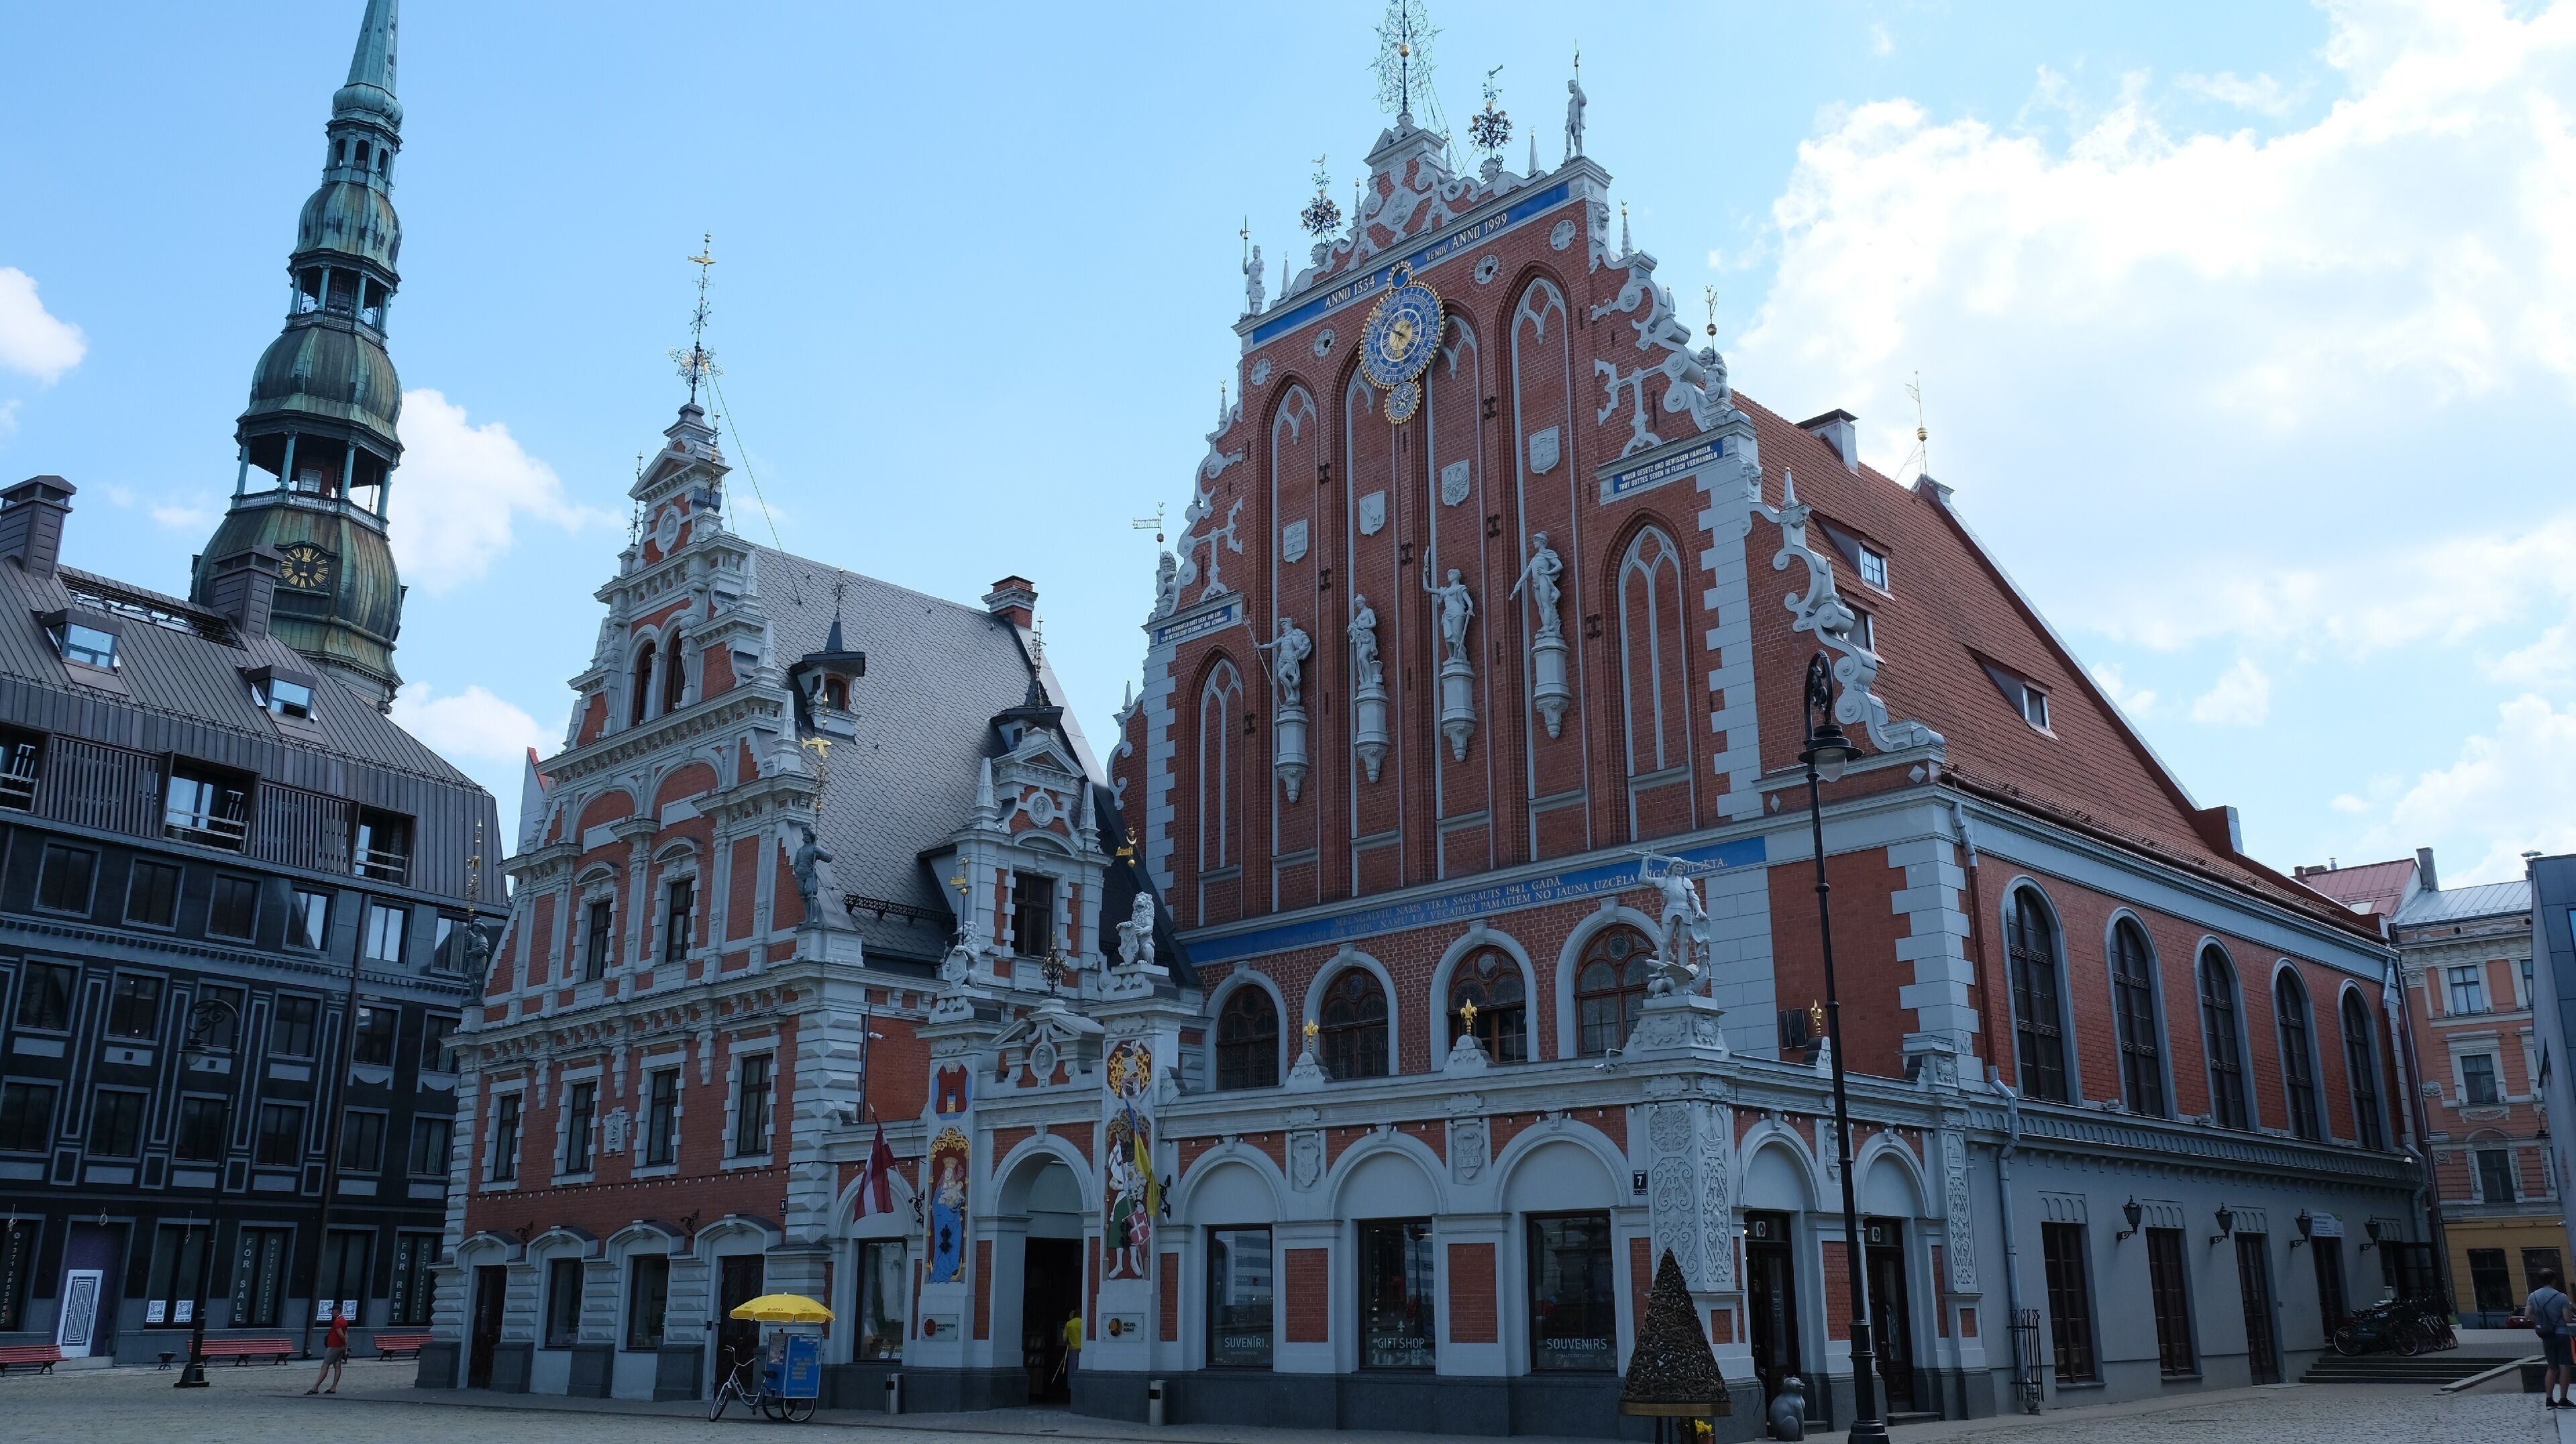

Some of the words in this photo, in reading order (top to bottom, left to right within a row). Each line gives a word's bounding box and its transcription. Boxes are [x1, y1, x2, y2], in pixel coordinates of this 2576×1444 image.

[1426, 245, 1449, 262] RENOV.
[1452, 225, 1480, 251] ANNO
[1485, 213, 1507, 234] 1999
[1325, 287, 1350, 310] ANNO
[1354, 275, 1375, 295] 1334
[1622, 472, 1635, 482] WIDER
[1637, 465, 1654, 476] GESETZ
[1654, 462, 1664, 470] UND
[1665, 453, 1688, 467] GEWISSEN
[1631, 476, 1648, 486] GOTTES
[1650, 470, 1664, 480] SEGEN
[1671, 463, 1685, 472] FLUCH
[1686, 452, 1717, 467] VERWANDELN
[1350, 922, 1375, 933] GODU
[1381, 917, 1407, 927] NAMU
[1413, 913, 1425, 922] UZ
[1430, 904, 1476, 919] VECAJIEM
[1481, 894, 1529, 911] PAMATIEM
[1536, 890, 1551, 899] NO
[1556, 882, 1589, 897] JAUNA
[1594, 874, 1635, 890] UZCĒLA
[1397, 904, 1421, 915] NAMS
[1425, 898, 1448, 910] TIKA
[1453, 888, 1500, 906] SAGRAUTS
[1506, 884, 1527, 895] 1941.
[1532, 876, 1563, 890] GADĀ.
[1637, 1176, 1642, 1186] 7
[243, 1238, 252, 1268] FOR
[398, 1243, 407, 1270] FOR
[235, 1280, 246, 1321] SALE
[393, 1281, 402, 1320] RENT
[1224, 1335, 1264, 1347] SUVENĪRI
[1378, 1337, 1397, 1349] GIFT
[1399, 1337, 1425, 1349] SHOP
[1547, 1338, 1607, 1349] SOUVENIRS
